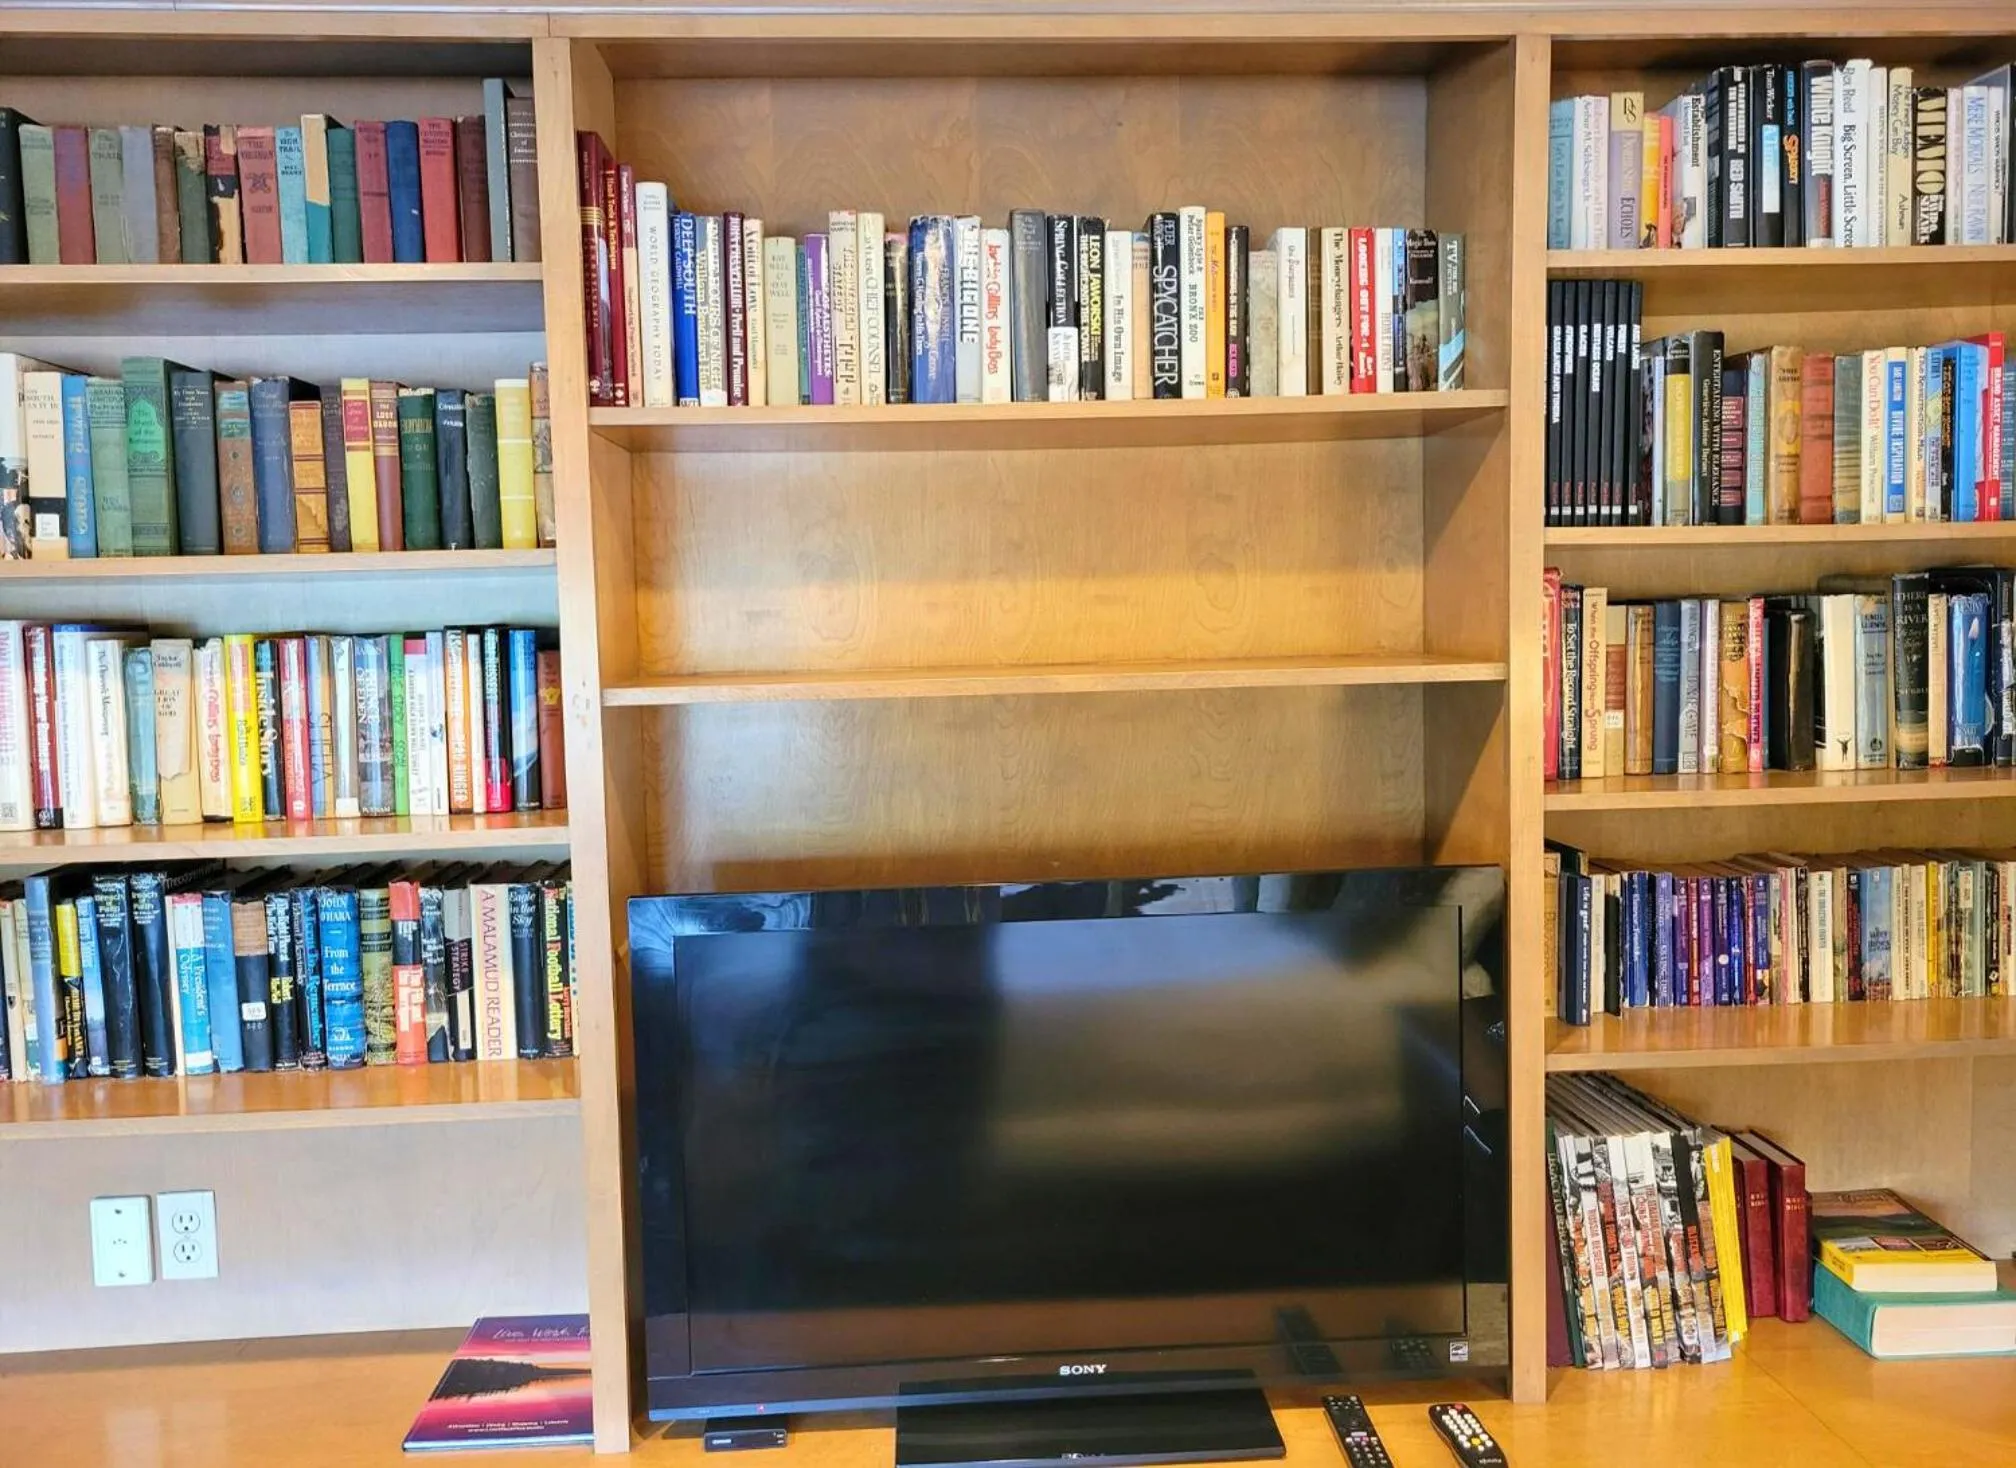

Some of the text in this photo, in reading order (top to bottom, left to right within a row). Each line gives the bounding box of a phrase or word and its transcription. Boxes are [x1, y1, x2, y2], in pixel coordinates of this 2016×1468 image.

[1691, 98, 1701, 167] Establishment
[1806, 75, 1833, 176] White Knight
[1842, 125, 1856, 142] Big
[1891, 85, 1902, 155] Money Can Buy
[1916, 97, 1946, 194] MEMO
[1730, 159, 1744, 219] RED SMITH
[1843, 185, 1856, 214] Little
[1166, 220, 1175, 245] PETER
[1334, 232, 1343, 250] The
[1446, 240, 1458, 265] TV
[681, 218, 695, 316] DEEP SOUTH
[746, 227, 760, 312] A Gift of Love
[1054, 220, 1069, 325] SPRING COLLECTION
[1090, 235, 1101, 335] LEON JAWORSKI
[1332, 255, 1344, 328] Moneychangers
[649, 226, 662, 381] WORLD GEOGRAPHY TODAY
[866, 277, 880, 373] CHIEF COUNSEL
[961, 267, 980, 344] BIG ONE
[987, 282, 1001, 320] Collins
[1153, 265, 1177, 387] SPYCATCHER
[1188, 284, 1198, 342] BRONX ZOO
[733, 313, 743, 397] Peril and Promise
[1081, 327, 1090, 362] POWER
[1113, 295, 1125, 382] In His Own Image
[1335, 334, 1343, 360] Arthur
[1869, 374, 1880, 398] Can
[1712, 349, 1721, 506] ENTERTAINING WITH ELEGANCE
[1890, 438, 1904, 484] INSPIRATION
[1590, 602, 1599, 625] When
[1567, 622, 1578, 748] To Set the Record Straight
[1587, 640, 1600, 690] Offspring
[255, 671, 278, 779] Inside Story
[357, 689, 367, 724] EDEN
[1585, 709, 1601, 751] Sprung
[321, 898, 347, 908] JOHN
[509, 892, 536, 904] Eagle
[512, 915, 532, 925] Sky
[180, 954, 191, 994] Odyssey
[324, 946, 348, 958] From
[330, 966, 344, 974] the
[451, 946, 461, 990] STRATEGY
[460, 942, 468, 973] STRIKE
[482, 891, 502, 1057] A MALAMUD READER
[544, 887, 563, 1040] National Football Lottery
[192, 954, 207, 1016] A President's
[1547, 1153, 1559, 1195] LEGACY
[1553, 1199, 1562, 1213] TO
[1059, 1364, 1107, 1376] SONY
